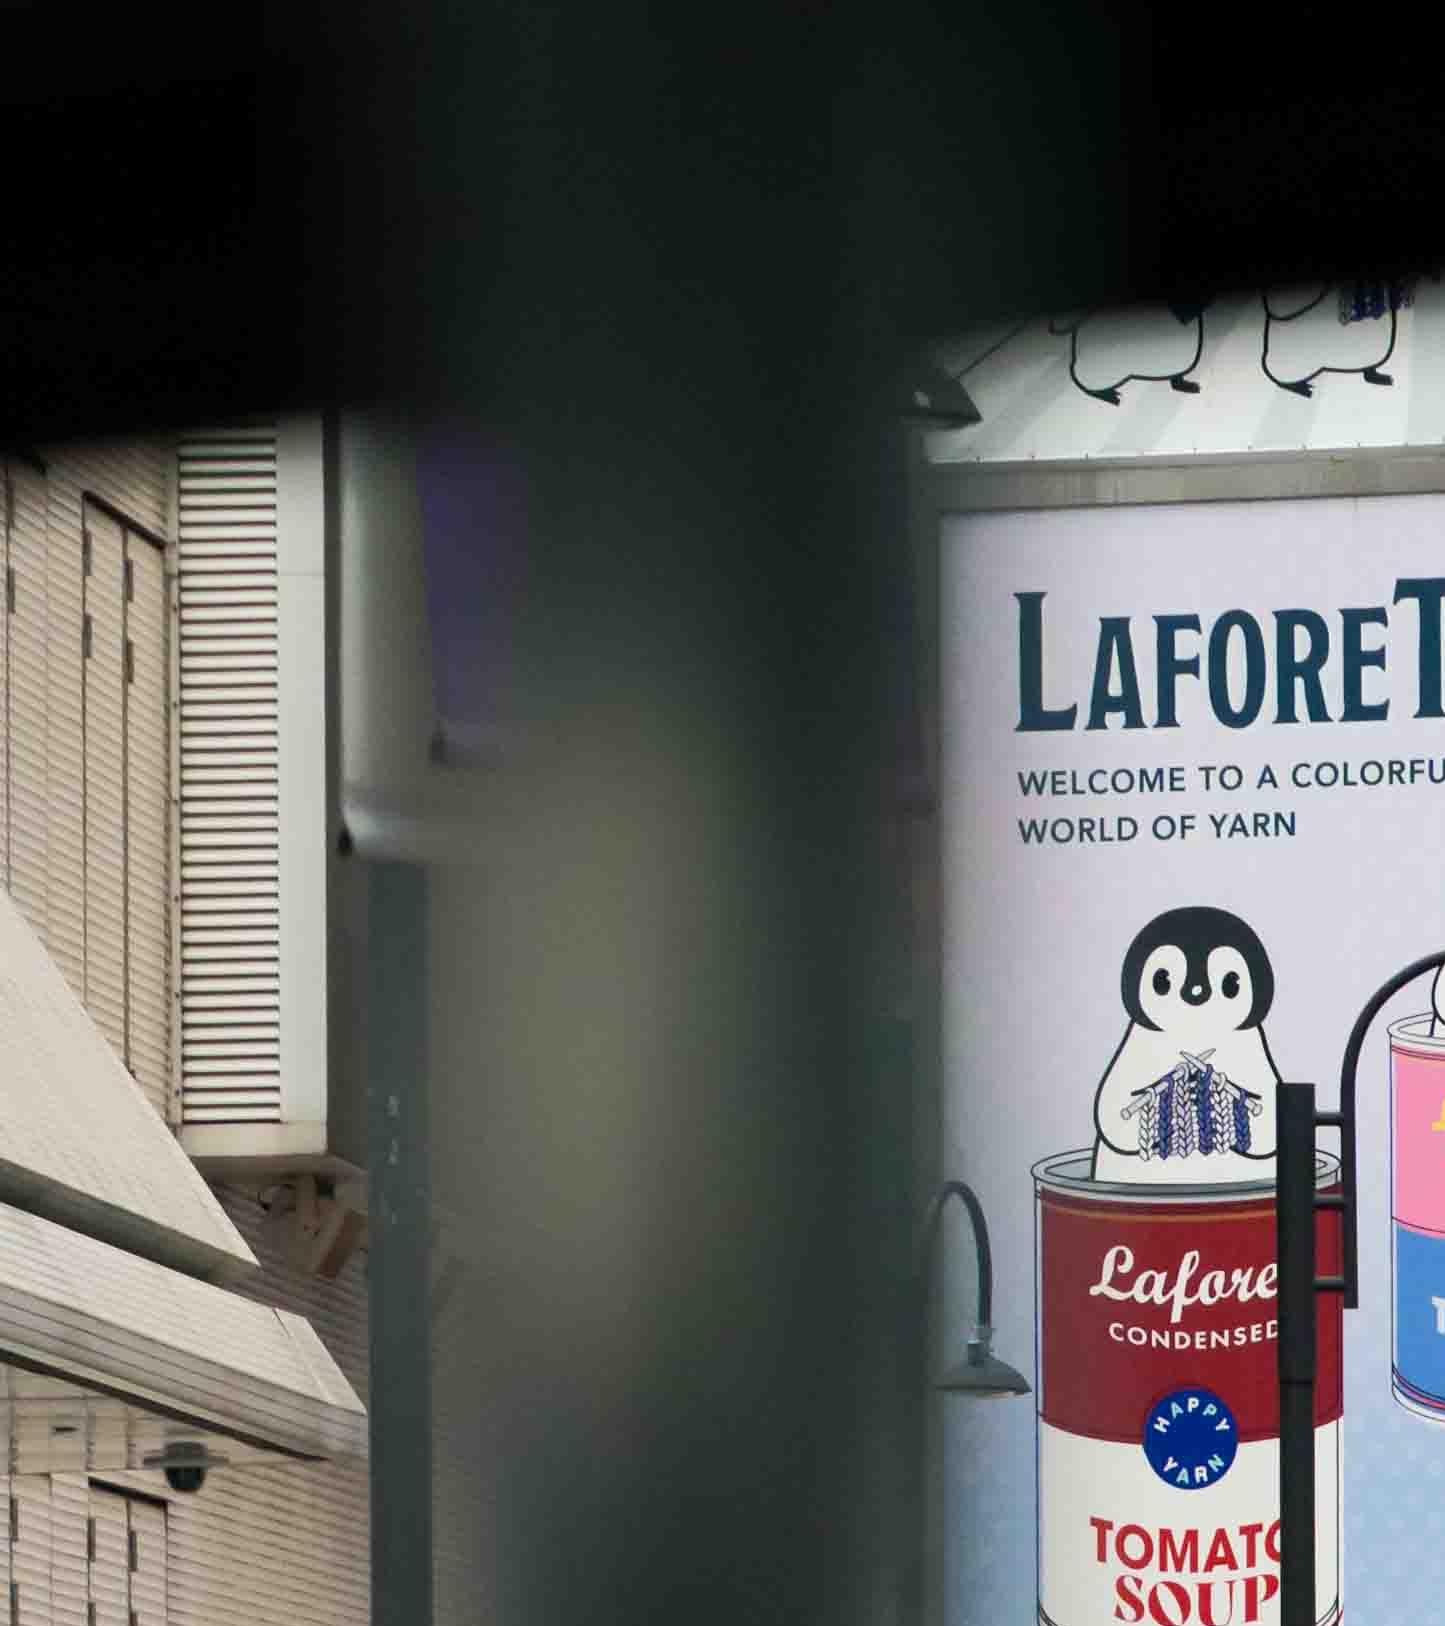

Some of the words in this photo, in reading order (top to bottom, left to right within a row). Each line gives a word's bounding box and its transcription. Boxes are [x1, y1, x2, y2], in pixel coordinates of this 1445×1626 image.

[1017, 766, 1186, 797] WELCOME
[1199, 764, 1244, 791] TO
[1256, 764, 1279, 790] A
[1017, 815, 1139, 844] WORLD
[1151, 813, 1196, 840] OF
[1208, 811, 1297, 839] YARN
[1088, 1245, 1279, 1324] Lafore
[1152, 1396, 1231, 1434] HAPPY
[1162, 1452, 1226, 1485] YARN
